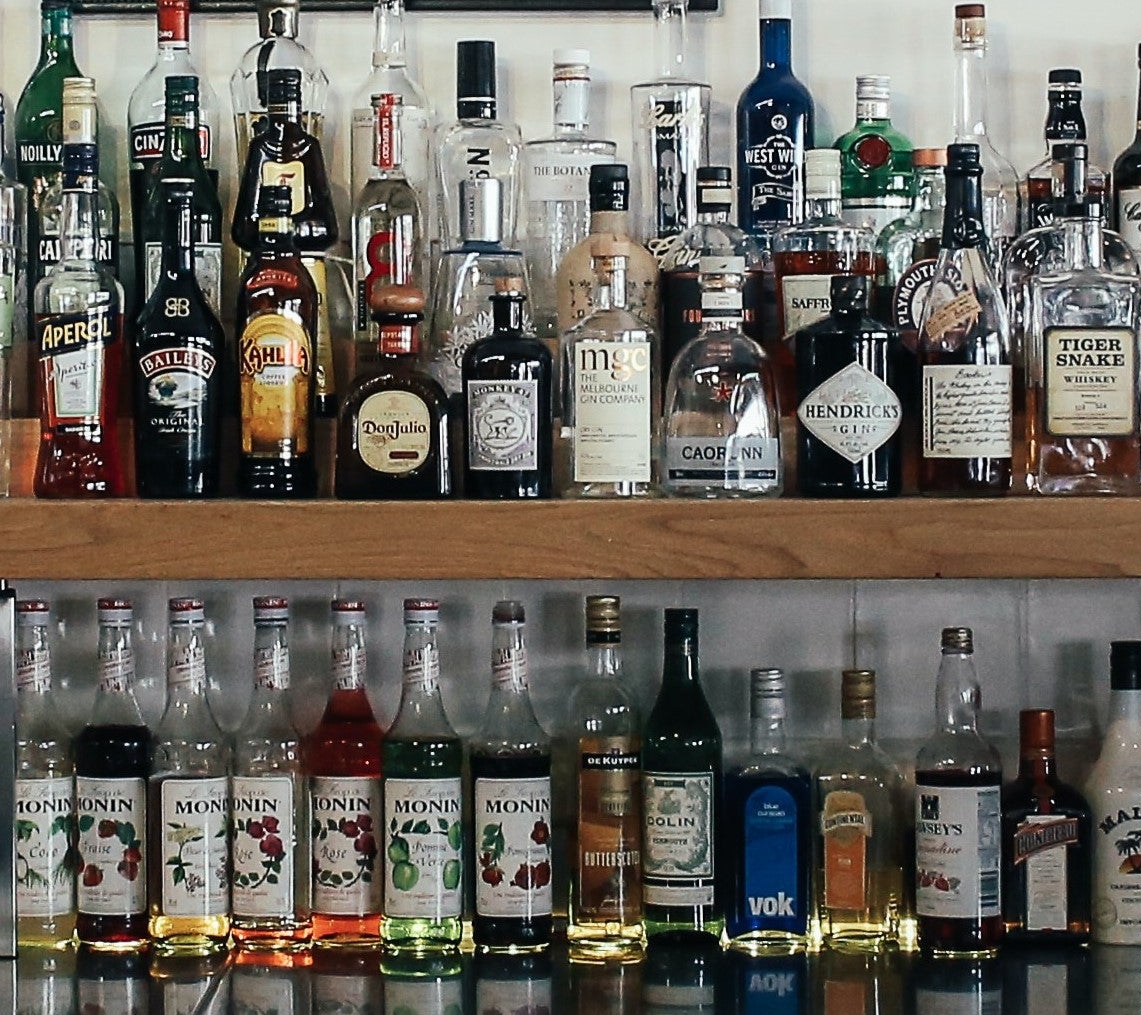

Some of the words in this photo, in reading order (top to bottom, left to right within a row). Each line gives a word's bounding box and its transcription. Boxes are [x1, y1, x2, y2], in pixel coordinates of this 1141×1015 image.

[20, 143, 63, 163] NOILLY
[744, 148, 775, 164] WEST
[552, 165, 592, 176] BOTAN
[791, 297, 831, 309] SAFFR
[897, 264, 938, 326] PLYMOUTH
[41, 316, 112, 351] APEROL
[1058, 338, 1122, 352] TIGER
[144, 349, 211, 373] BAILEYS
[239, 337, 311, 375] KAHLA
[580, 346, 647, 382] mgc
[1055, 353, 1126, 367] SNAKE
[579, 373, 598, 383] THE
[1063, 375, 1117, 383] WHISKEY
[579, 383, 639, 394] MELBOURNE
[579, 394, 599, 404] GIN
[598, 394, 646, 404] COMPANY
[805, 404, 899, 420] HENDRICK'S
[839, 424, 871, 434] GIN
[77, 797, 134, 813] ONIN
[394, 798, 461, 814] MONIN
[485, 797, 550, 813] MONIN
[647, 816, 696, 827] DOLIN
[747, 891, 796, 917] vok
